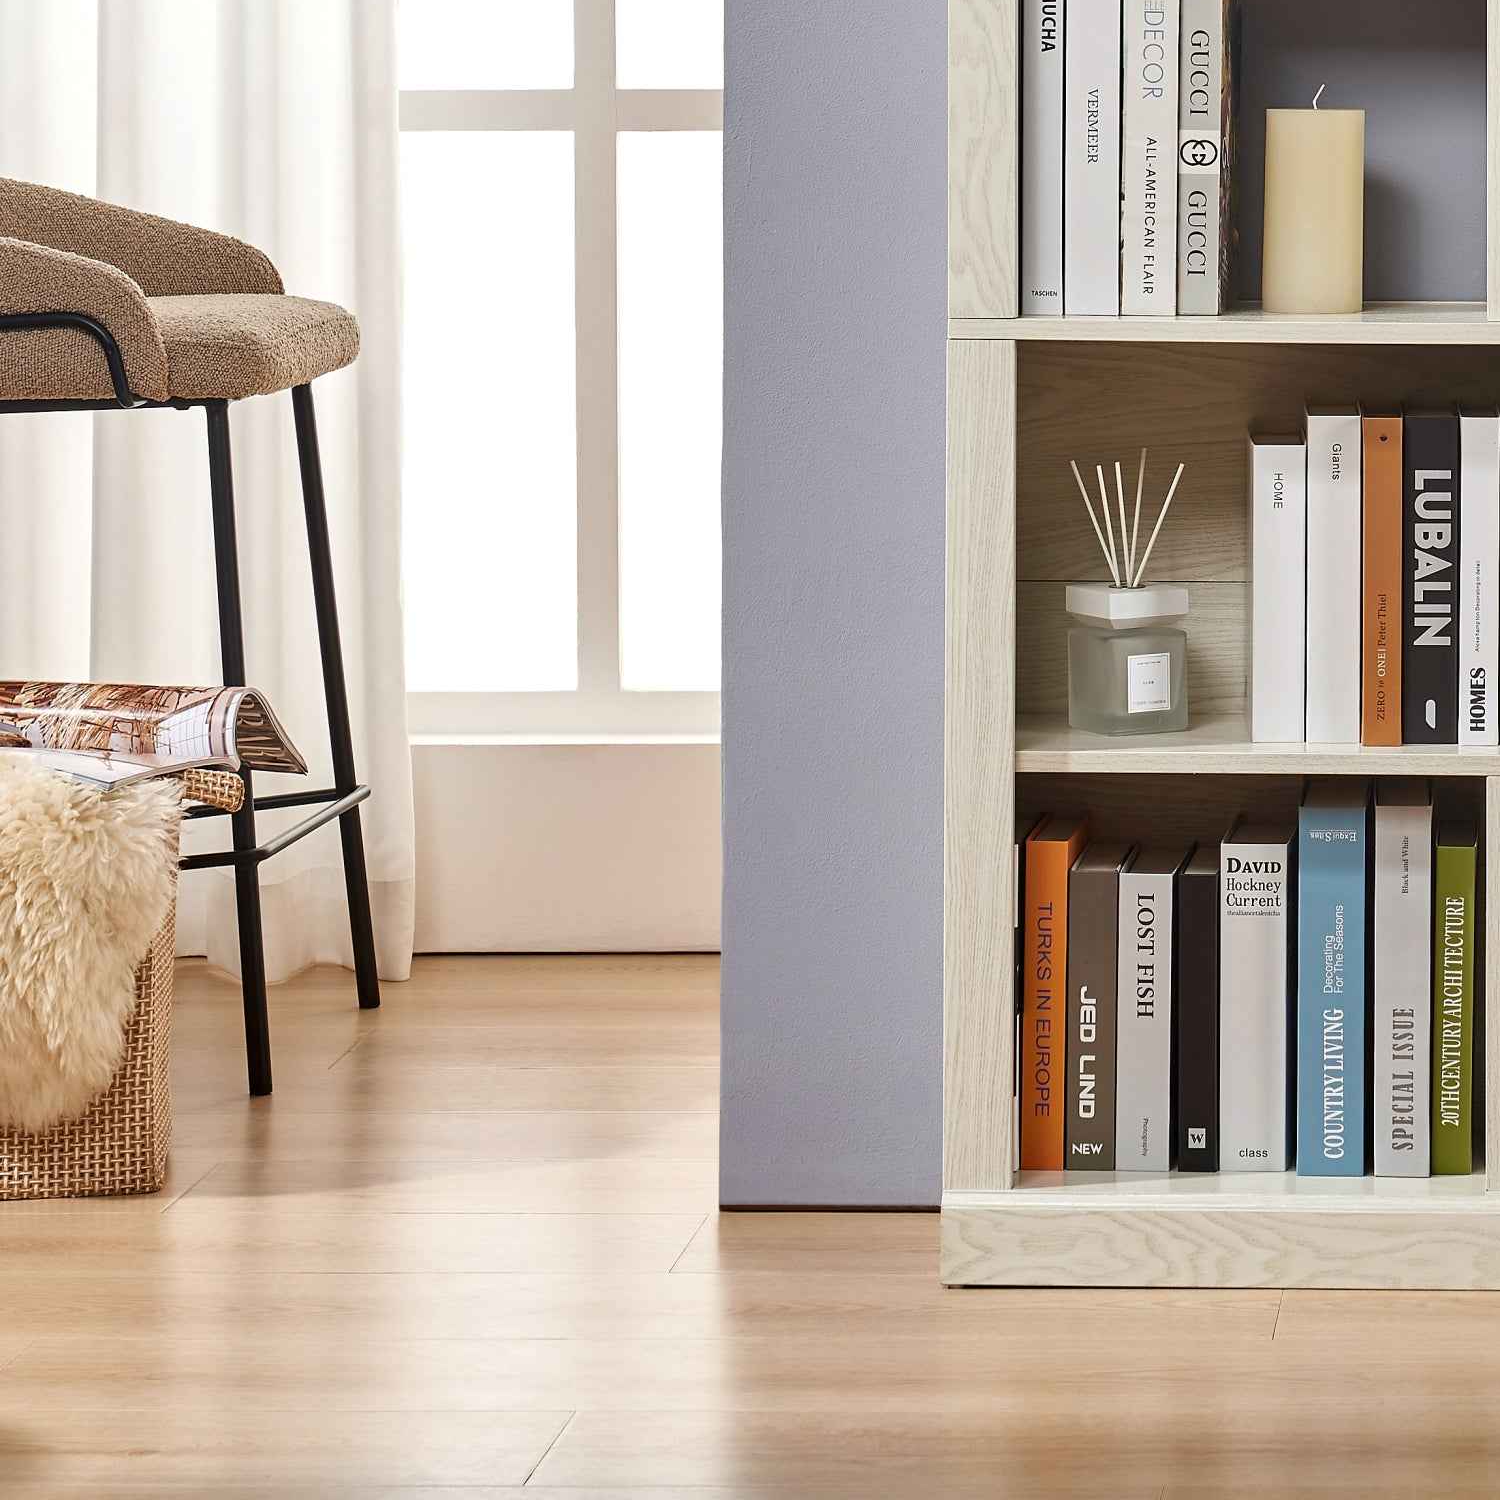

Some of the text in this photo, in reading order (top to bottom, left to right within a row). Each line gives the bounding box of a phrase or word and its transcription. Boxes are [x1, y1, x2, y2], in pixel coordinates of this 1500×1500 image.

[1142, 10, 1164, 100] DECOR
[1190, 30, 1209, 116] GUCCI
[1087, 89, 1099, 164] VERMEER
[1143, 137, 1157, 294] ALL-AMERICAN FLAIR
[1187, 191, 1208, 276] GUCCI
[1273, 473, 1283, 508] HOME
[1331, 443, 1342, 480] Giants
[1413, 469, 1452, 646] LUBALIN
[1376, 620, 1388, 647] Peter
[1378, 594, 1388, 619] Thiel
[1376, 653, 1387, 677] ONE
[1376, 691, 1387, 721] ZERO
[1470, 668, 1486, 732] HOMES
[1227, 878, 1281, 894] Hockney
[1227, 894, 1281, 907] Current
[1137, 894, 1155, 1019] LOST FISH
[1323, 935, 1334, 993] Decorating
[1334, 905, 1344, 994] For The Seasons
[1035, 902, 1053, 1116] TURKS IN EUROPE
[1078, 986, 1096, 1118] JED LIND
[1391, 1008, 1414, 1151] SPECIAL ISSUE
[1323, 1009, 1345, 1159] COUNTRY LIVING
[1072, 1143, 1103, 1155] NEW
[1141, 1118, 1150, 1156] Photography
[1190, 1134, 1204, 1144] W
[1239, 1148, 1269, 1158] class
